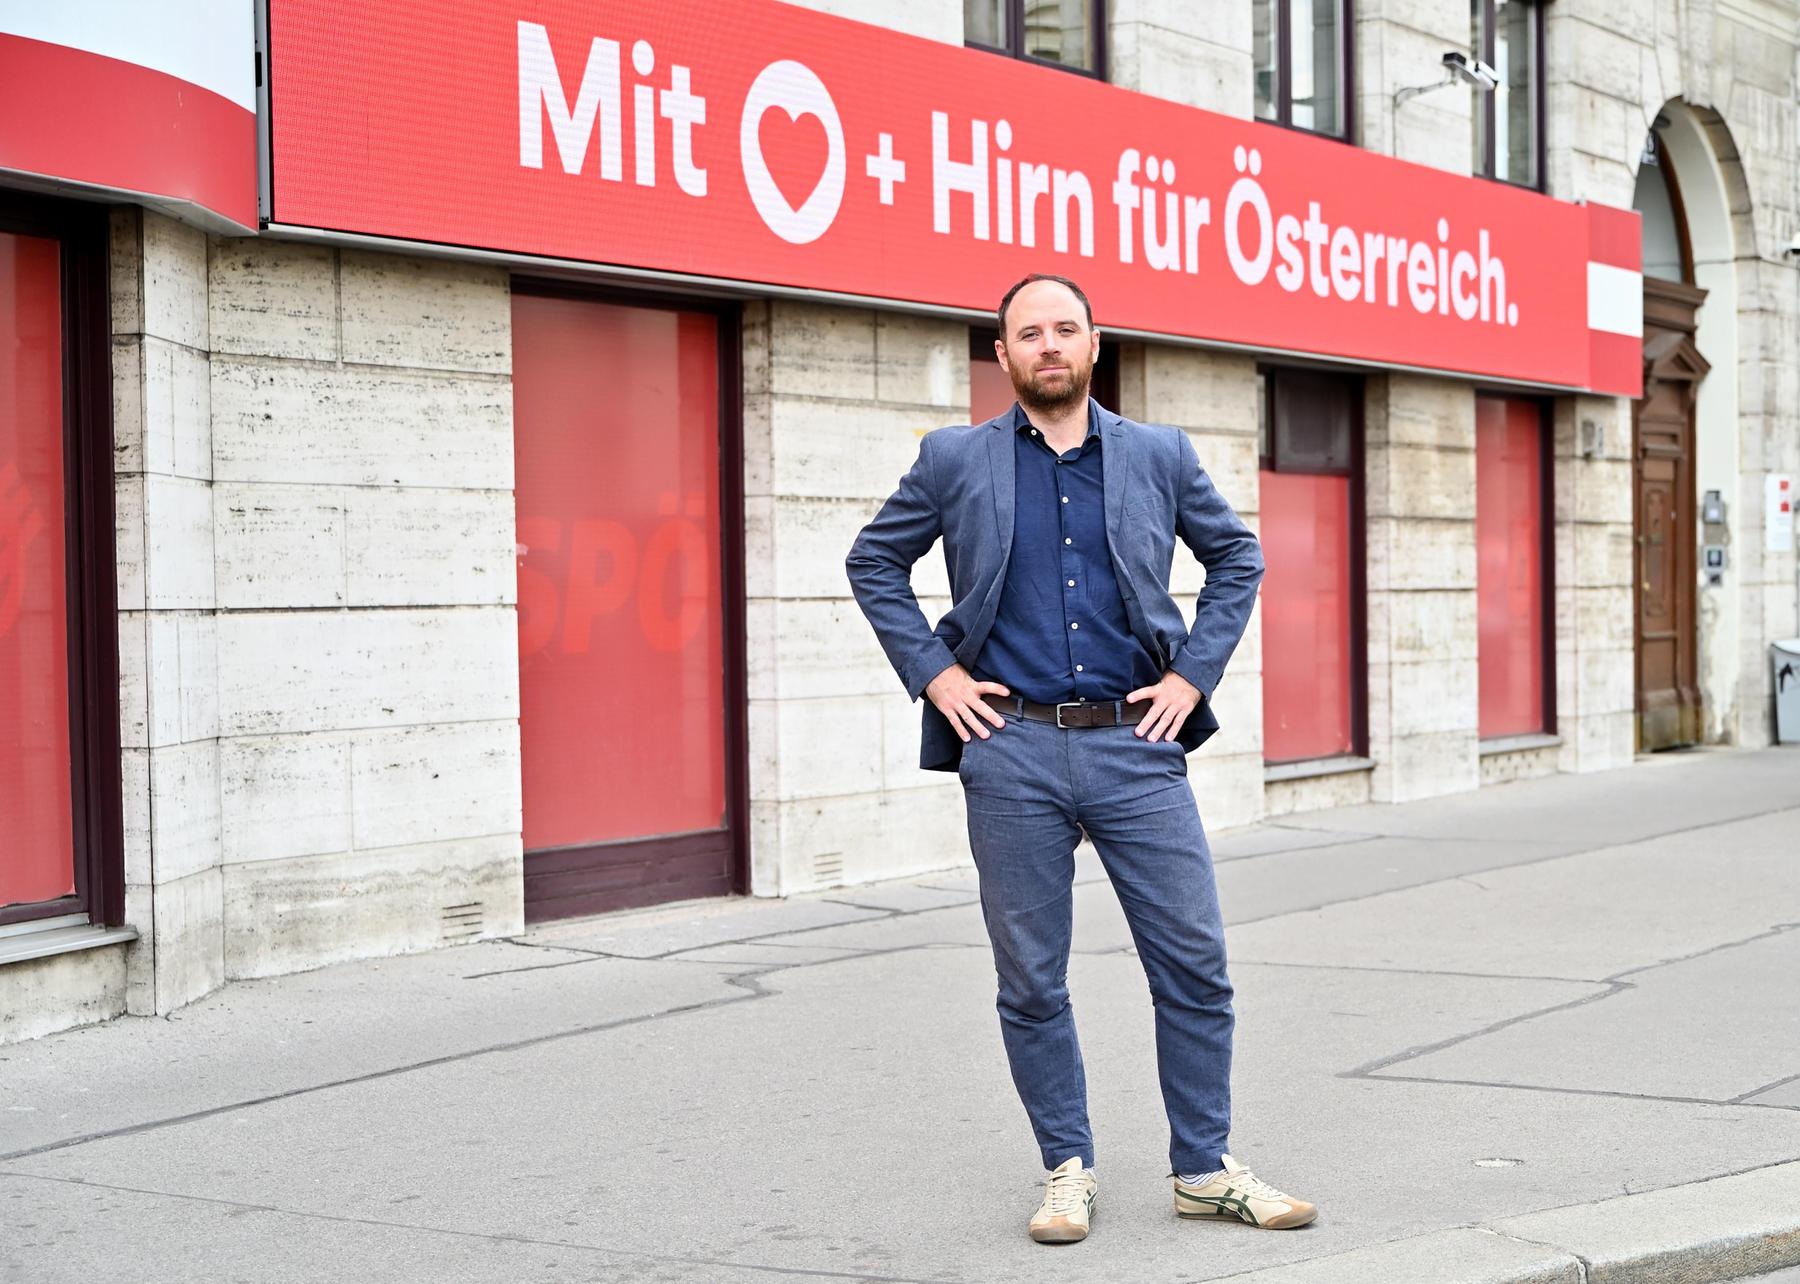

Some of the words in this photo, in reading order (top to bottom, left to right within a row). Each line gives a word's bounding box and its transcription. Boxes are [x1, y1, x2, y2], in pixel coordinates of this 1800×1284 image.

[517, 20, 708, 197] Mit
[931, 111, 1095, 258] Hirn
[1112, 146, 1211, 275] für
[1224, 145, 1519, 327] Österreich.
